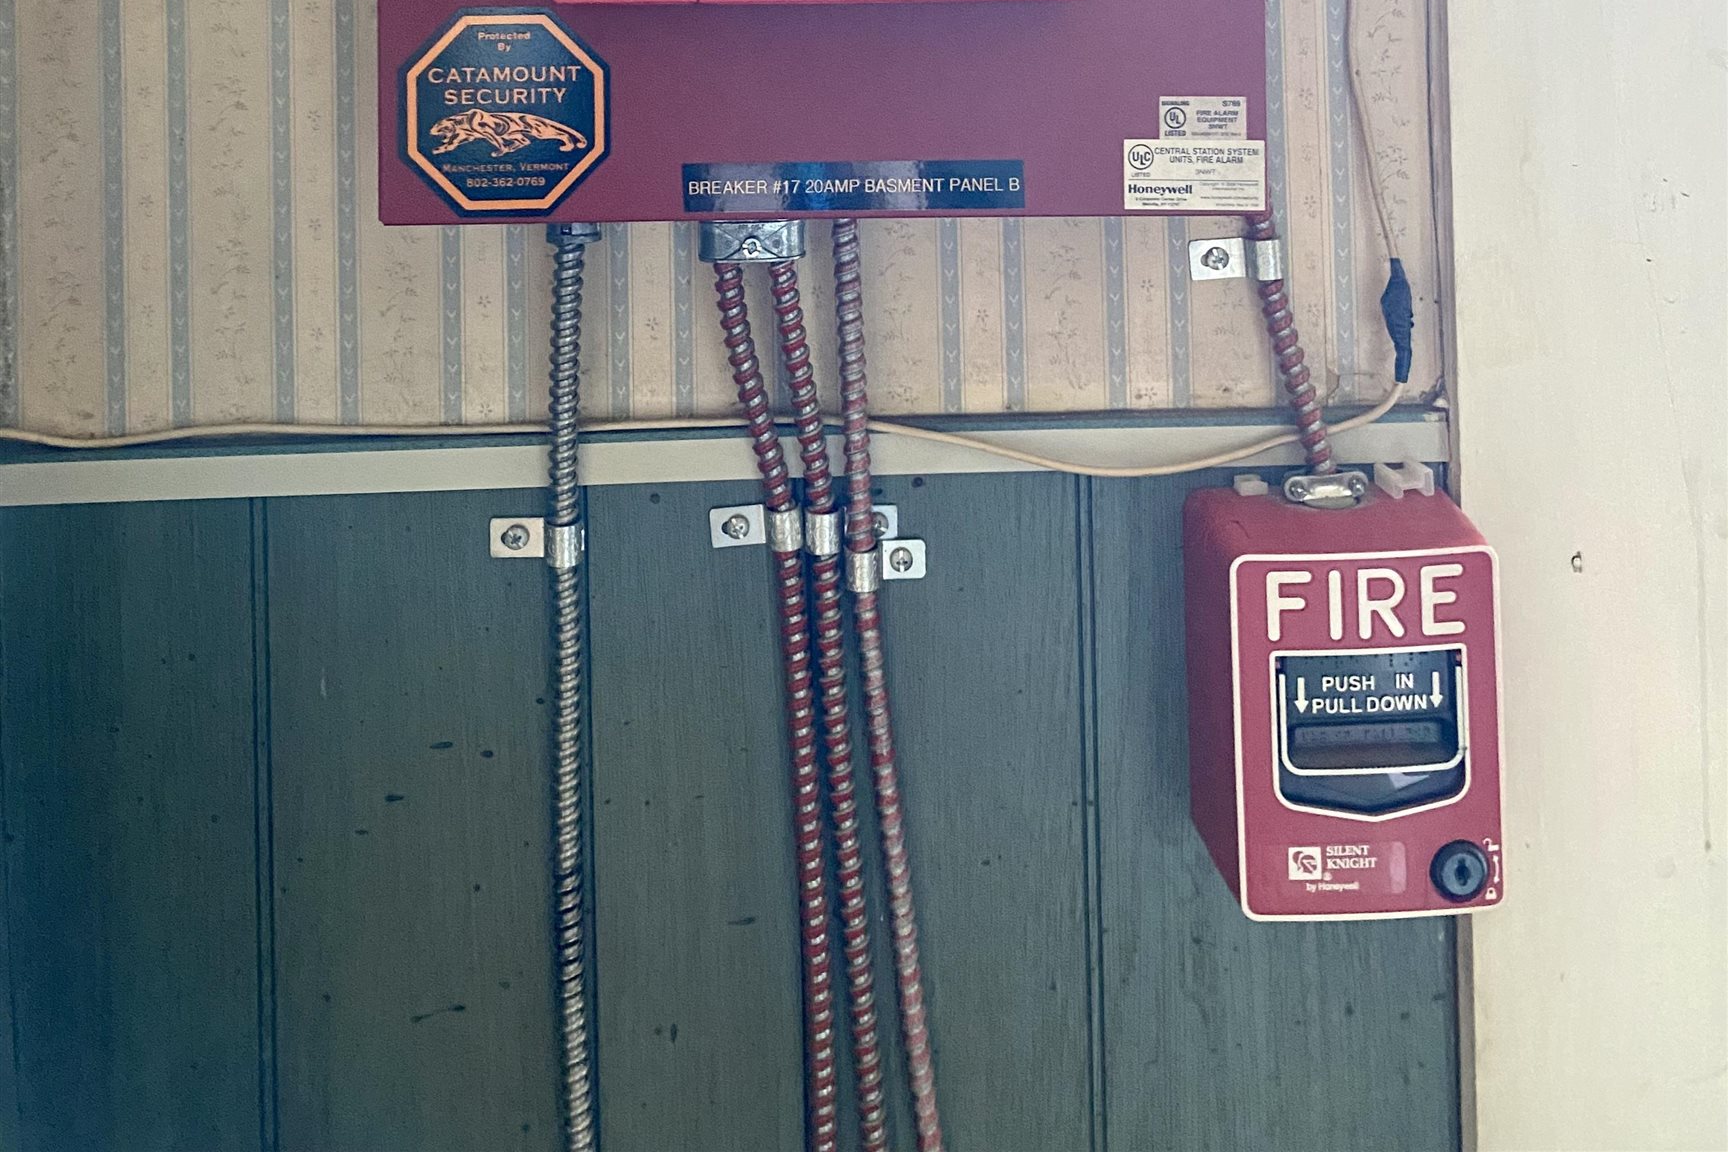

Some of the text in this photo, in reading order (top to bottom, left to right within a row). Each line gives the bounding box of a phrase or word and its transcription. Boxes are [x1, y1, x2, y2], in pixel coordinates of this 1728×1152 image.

[477, 32, 531, 40] Protected
[497, 43, 511, 52] By
[427, 66, 581, 84] CATAMOUNT
[444, 88, 567, 105] SECURITY
[1169, 111, 1181, 125] UL
[1154, 147, 1259, 156] CENTRAL STATION SYSTEM
[1169, 156, 1195, 164] UNITS,
[1215, 156, 1244, 164] ALARM
[520, 162, 569, 171] VERMONT
[466, 177, 546, 187] 802-362-0769
[688, 177, 1020, 195] BREAKER #17 20AMP BASMENT PANEL B
[1128, 184, 1193, 196] Honeywell
[1266, 563, 1466, 642] FIRE
[1322, 673, 1414, 692] PUSH IN
[1311, 694, 1427, 714] PULL DOWN
[1326, 845, 1370, 856] SILENT
[1327, 857, 1377, 869] KNIGHT
[1306, 881, 1360, 892] by Honeywell
